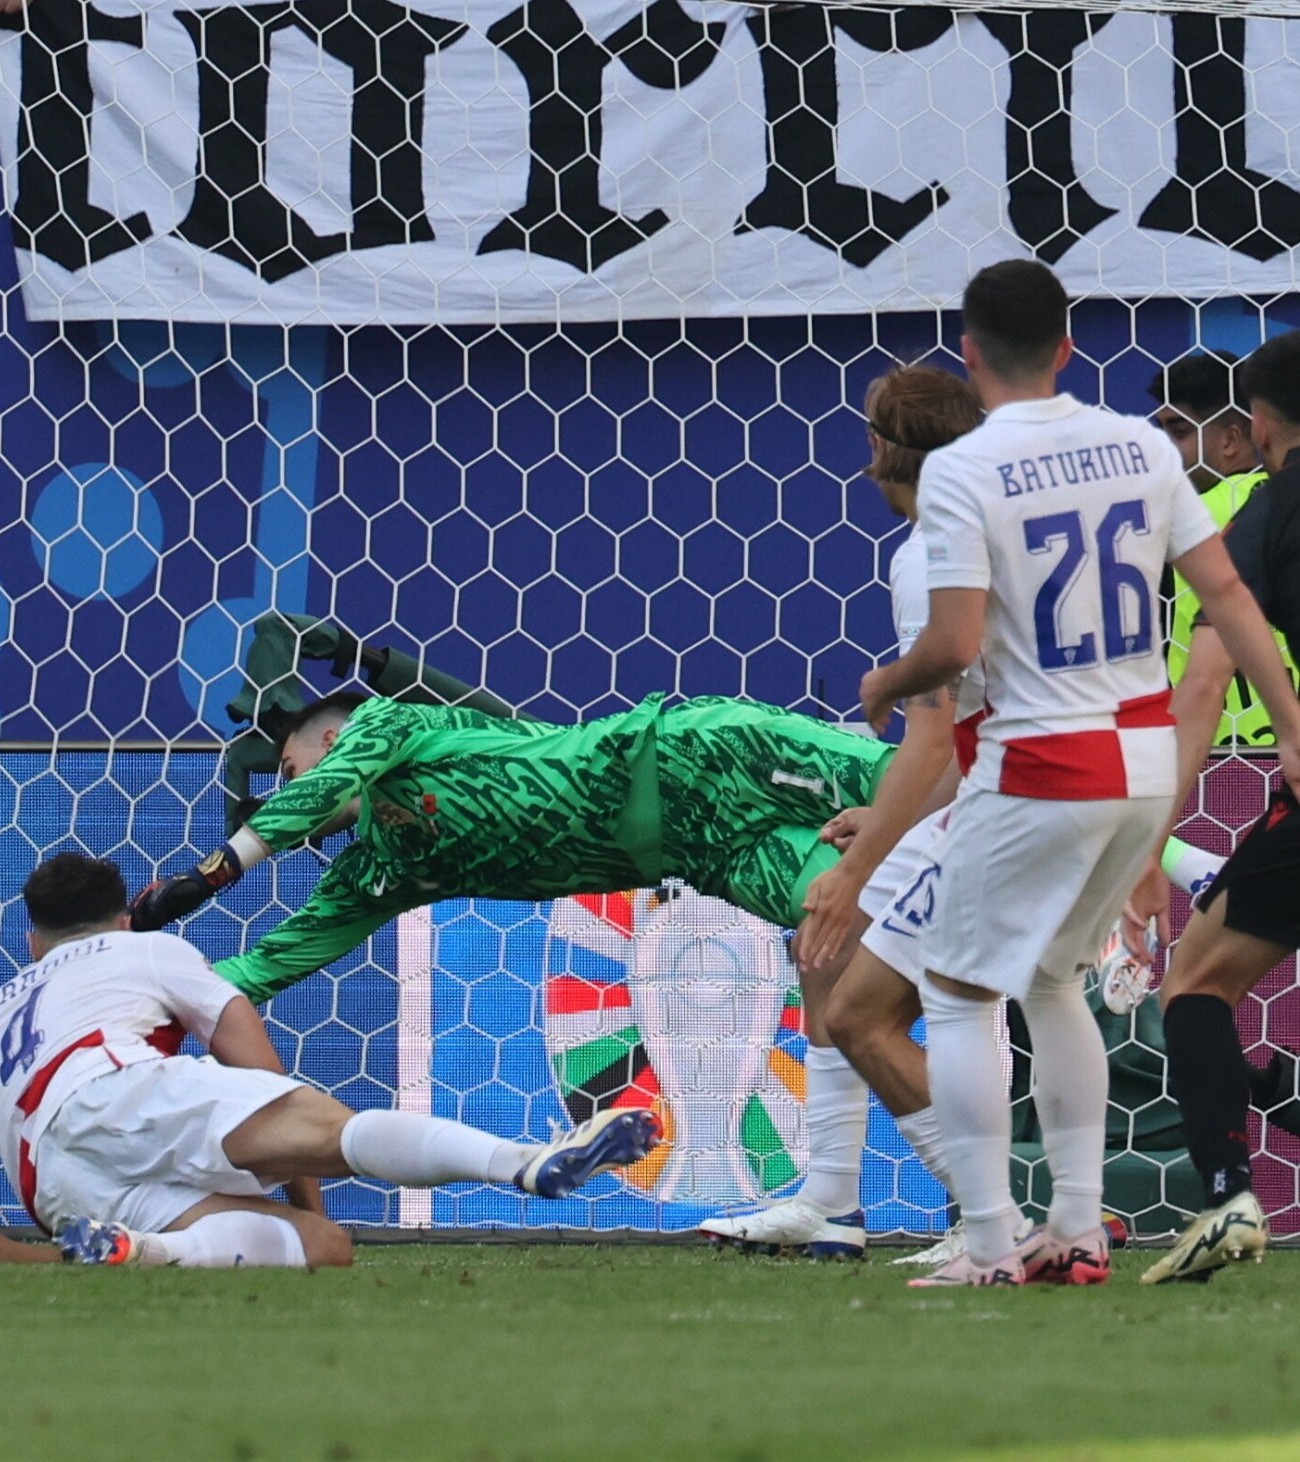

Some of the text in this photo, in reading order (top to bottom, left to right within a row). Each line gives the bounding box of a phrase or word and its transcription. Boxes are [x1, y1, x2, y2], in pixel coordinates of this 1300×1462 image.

[997, 441, 1150, 498] BATURINA
[1022, 498, 1153, 674] 26
[0, 979, 49, 1087] 4
